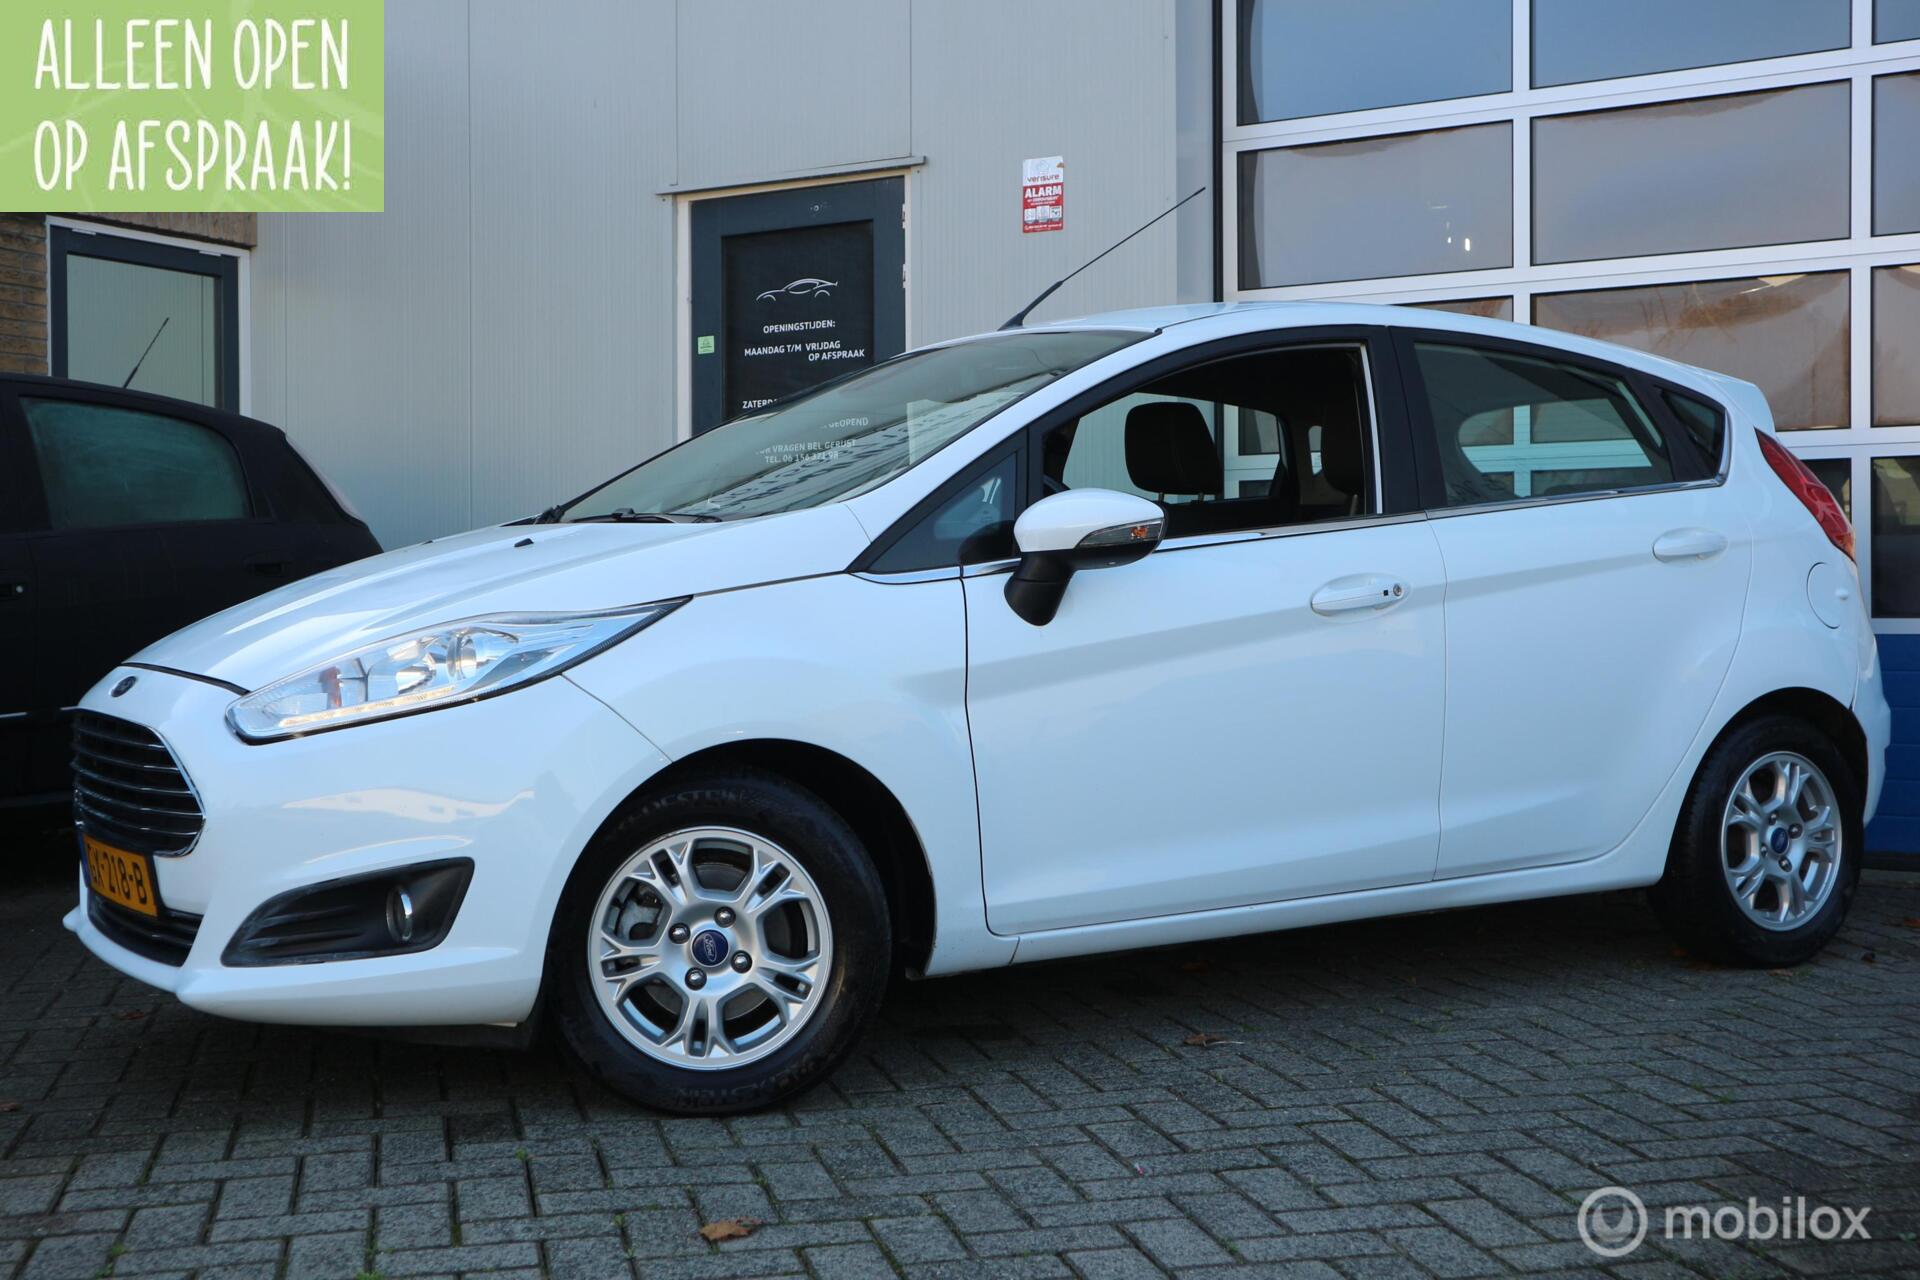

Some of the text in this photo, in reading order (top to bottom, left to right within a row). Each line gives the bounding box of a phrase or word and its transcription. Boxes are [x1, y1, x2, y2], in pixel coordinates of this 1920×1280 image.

[1027, 174, 1060, 183] verisure
[1025, 185, 1062, 199] ALARM
[763, 319, 836, 334] OPENINGSTIJDEN:
[744, 340, 841, 357] MAANDAG T/M VRIJDAG
[808, 349, 865, 362] OP AFSPRAAK
[807, 441, 823, 450] BEL
